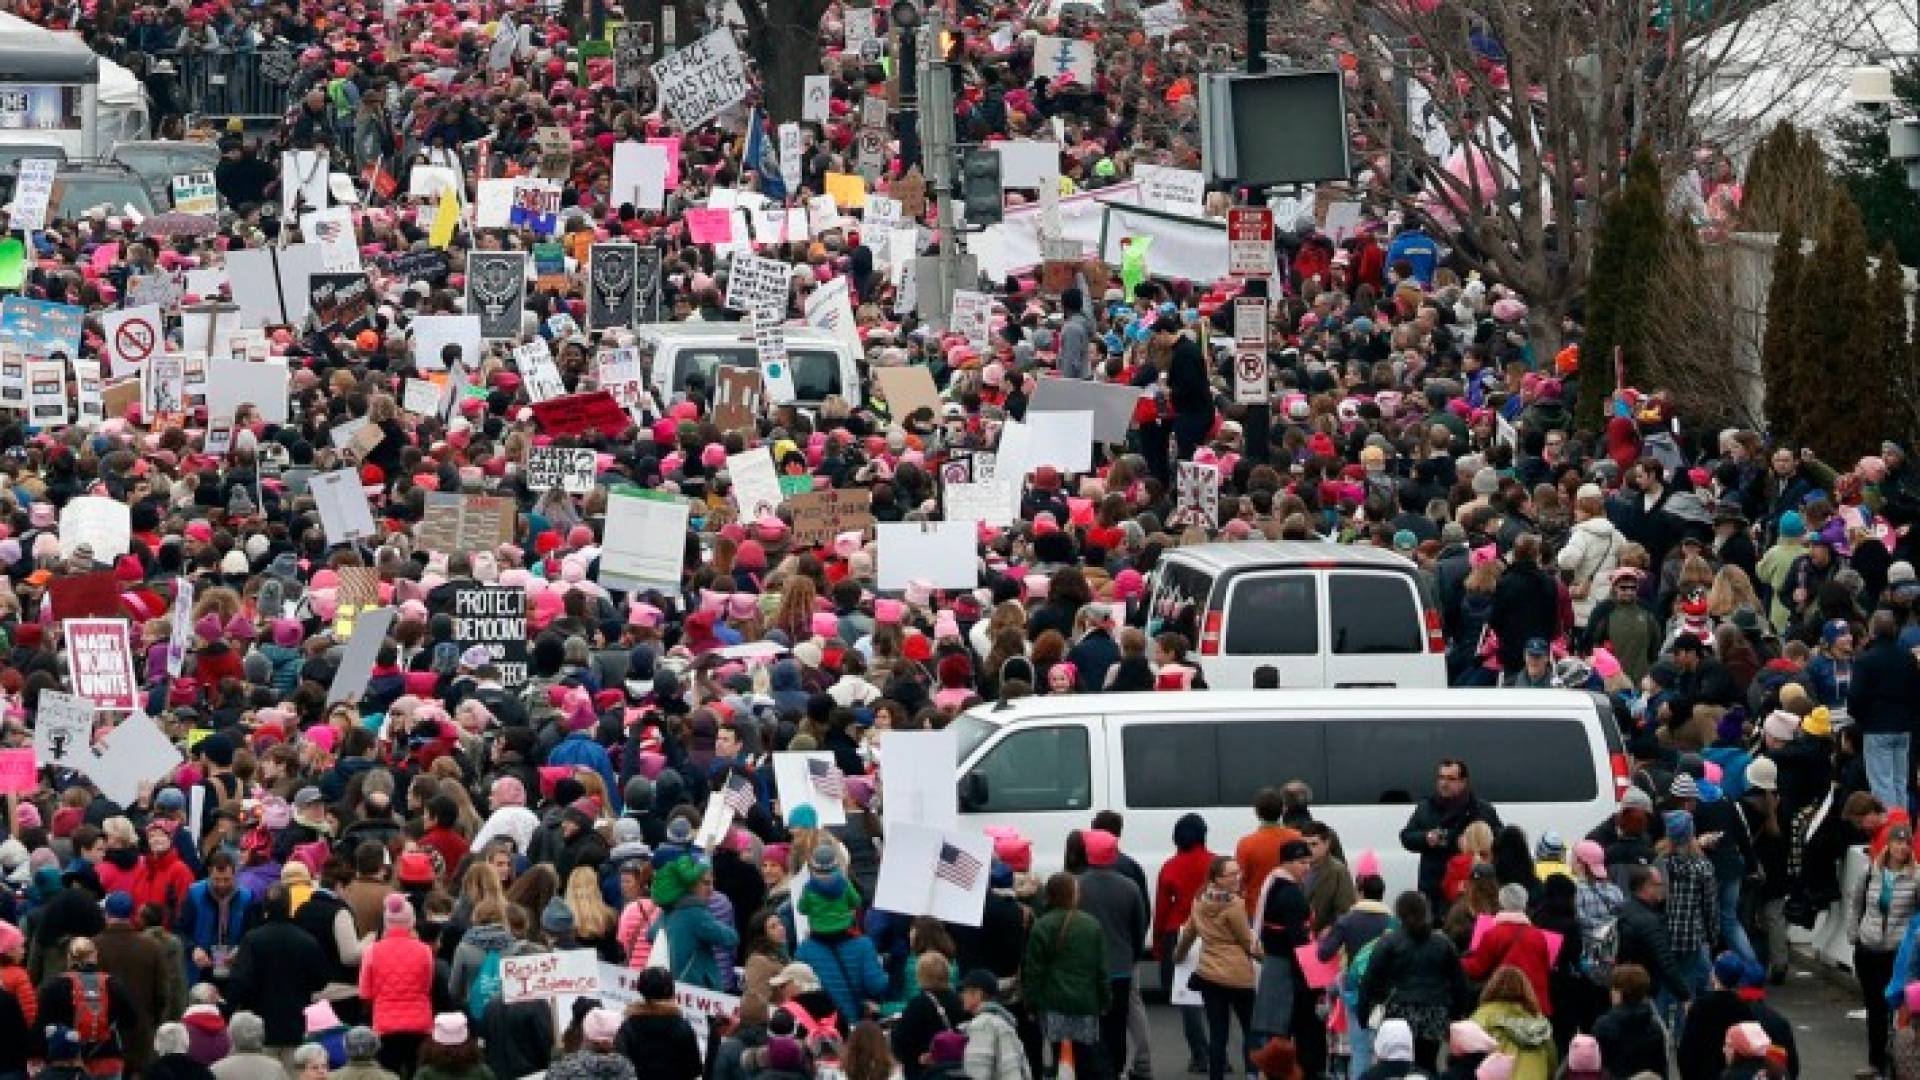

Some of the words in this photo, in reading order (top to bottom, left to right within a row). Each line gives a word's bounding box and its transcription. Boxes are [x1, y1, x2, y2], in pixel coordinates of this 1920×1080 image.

[655, 38, 716, 83] PEACE
[666, 53, 735, 109] JUSTICE
[677, 74, 745, 127] EQUALITY
[455, 589, 528, 615] PROTECT
[80, 674, 128, 696] UNITE
